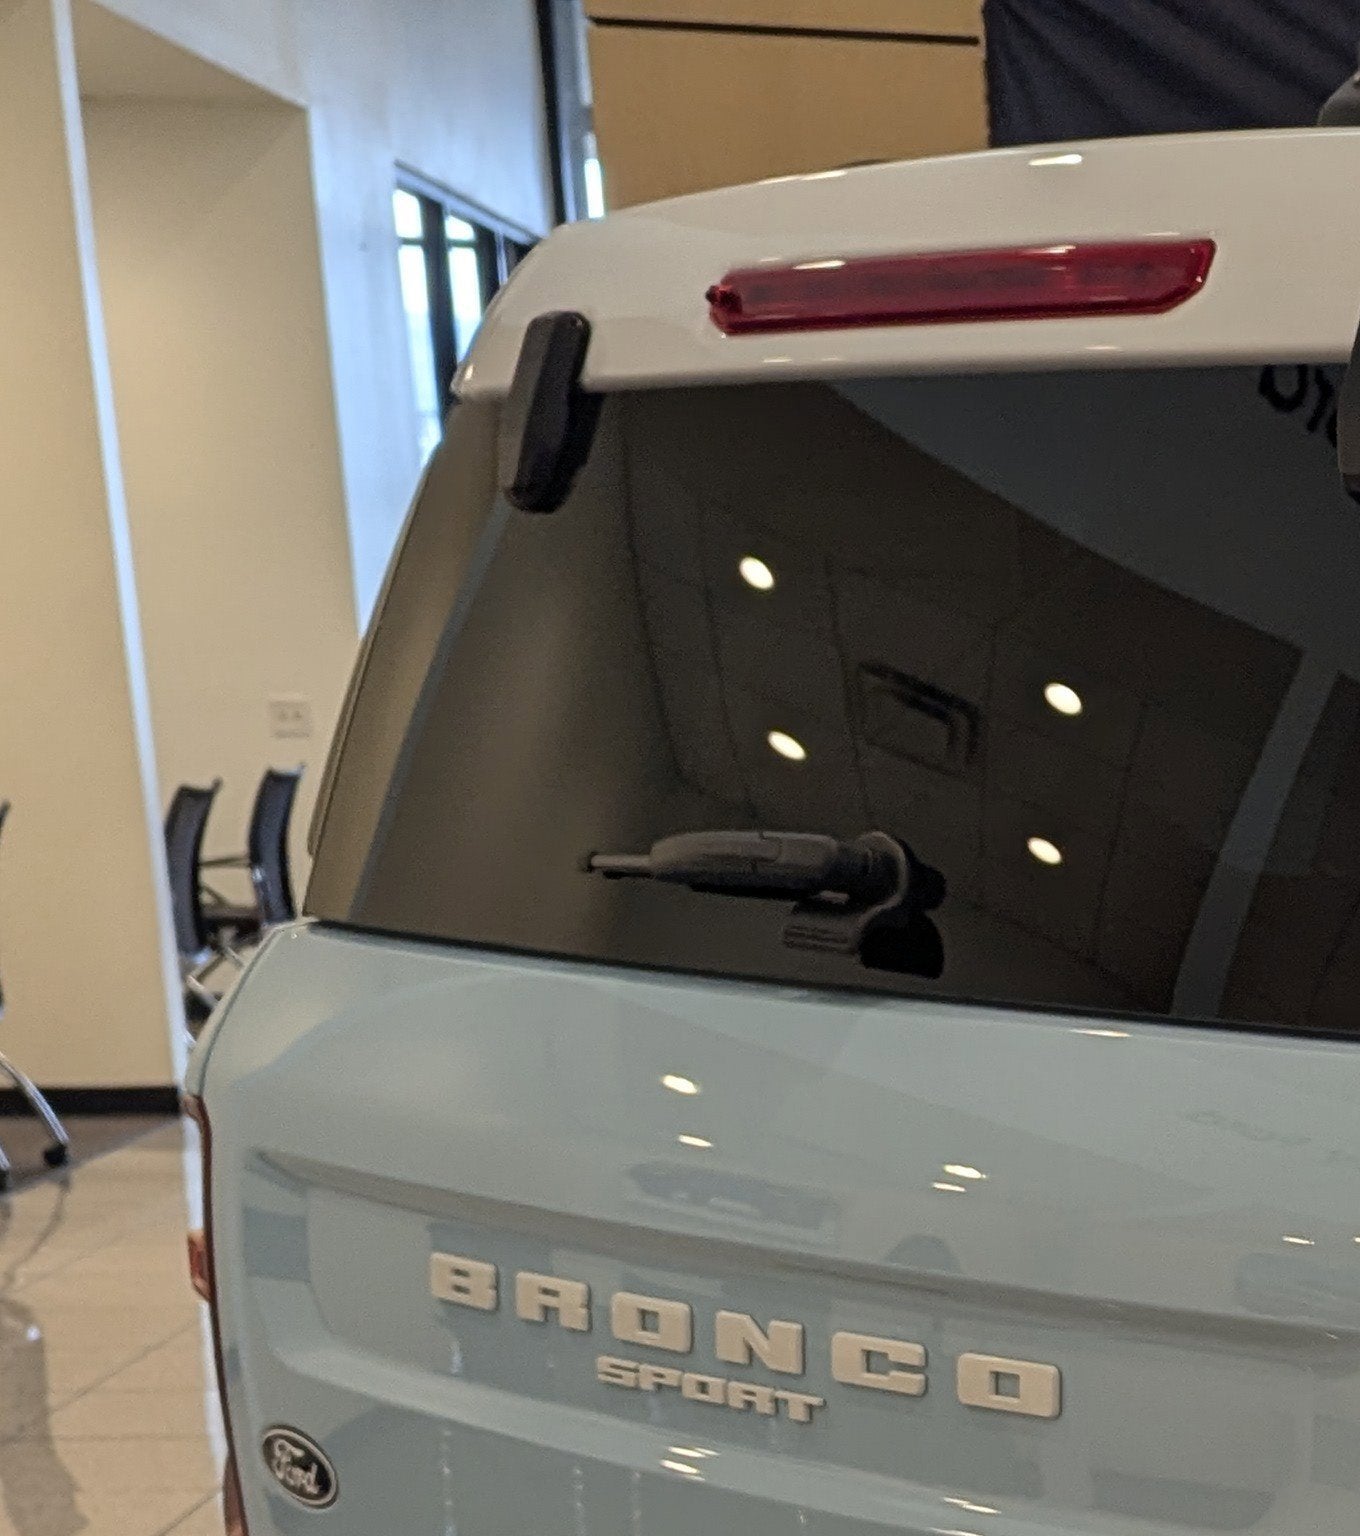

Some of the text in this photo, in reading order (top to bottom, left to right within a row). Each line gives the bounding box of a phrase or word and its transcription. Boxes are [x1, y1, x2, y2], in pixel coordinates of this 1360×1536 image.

[431, 1251, 1062, 1419] BRONCO
[596, 1356, 825, 1423] SPORT
[267, 1433, 329, 1502] Ford
